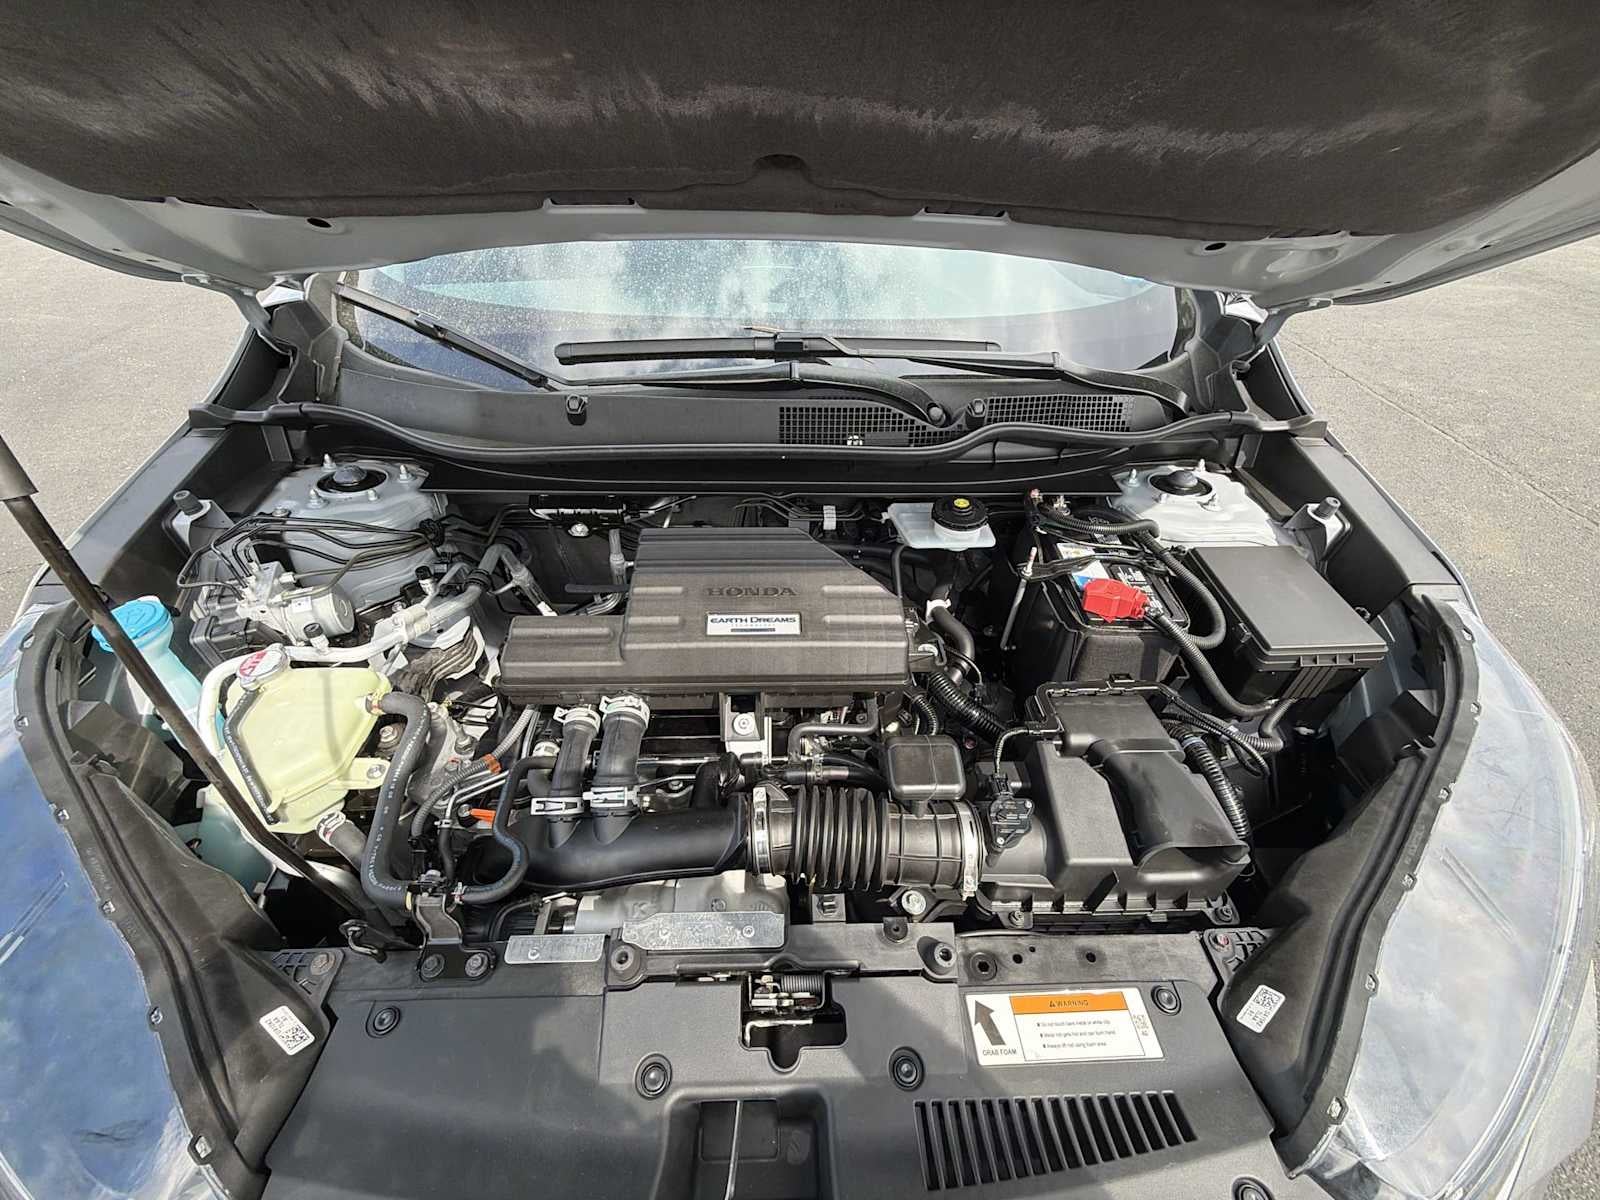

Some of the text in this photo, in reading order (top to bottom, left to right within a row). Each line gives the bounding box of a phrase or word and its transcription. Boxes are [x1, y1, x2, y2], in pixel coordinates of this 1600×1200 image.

[708, 586, 797, 597] HONDA
[1057, 999, 1089, 1008] WARNING
[1000, 1047, 1017, 1055] FOAM
